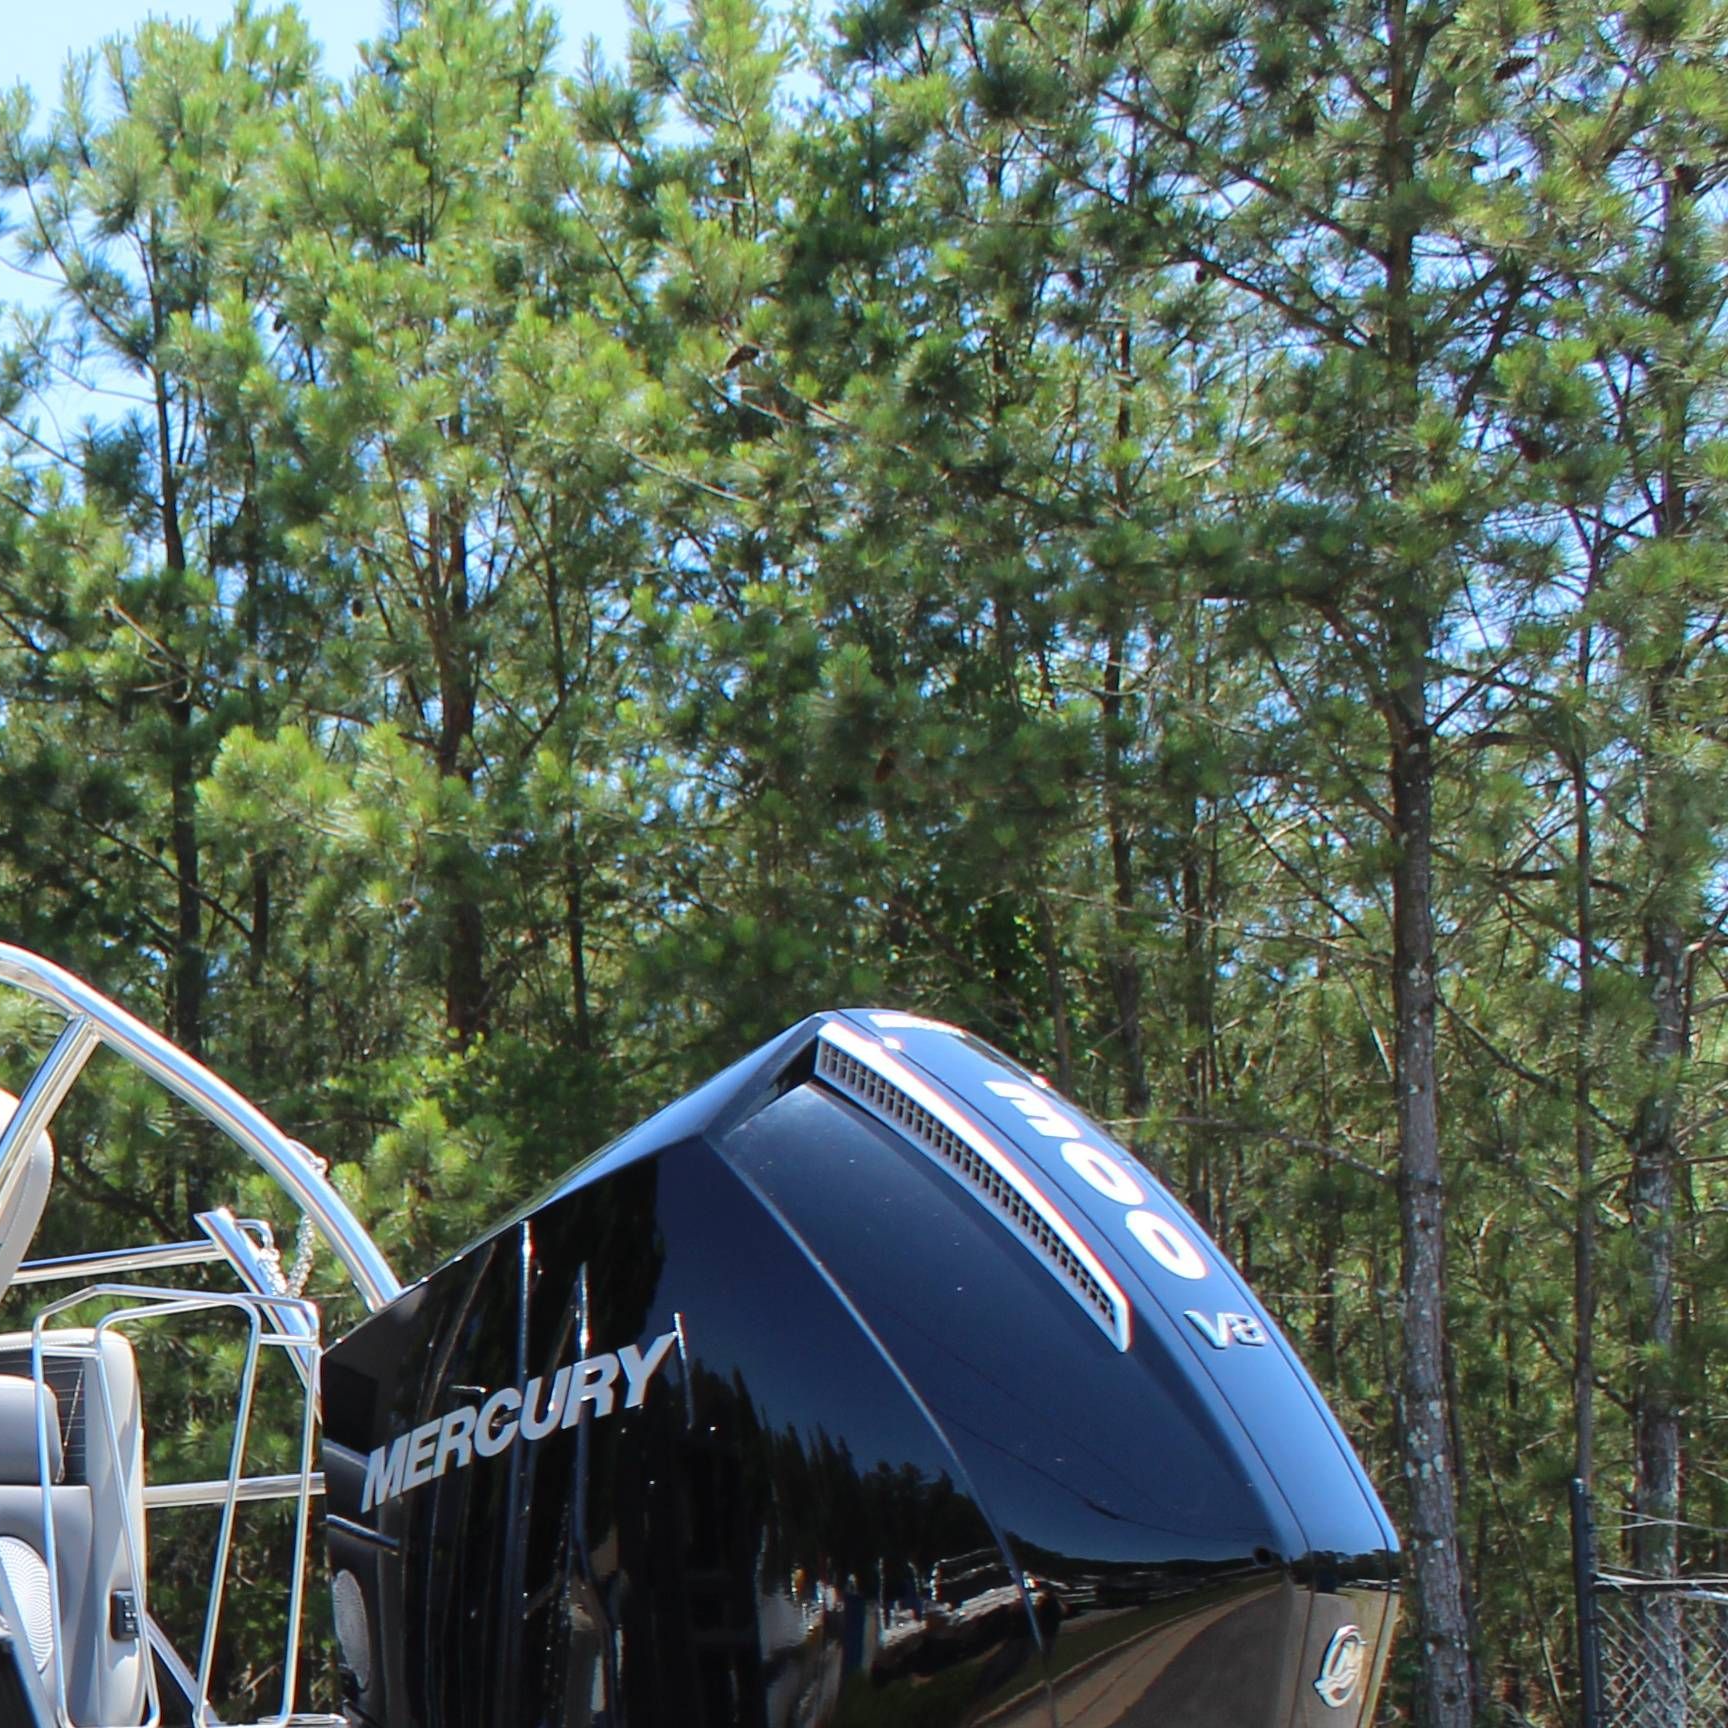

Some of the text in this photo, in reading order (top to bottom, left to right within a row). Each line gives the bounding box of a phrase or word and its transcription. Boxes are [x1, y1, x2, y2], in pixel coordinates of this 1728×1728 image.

[983, 1080, 1207, 1280] 300
[1184, 1310, 1265, 1349] V8
[361, 1331, 678, 1513] MERCURY
